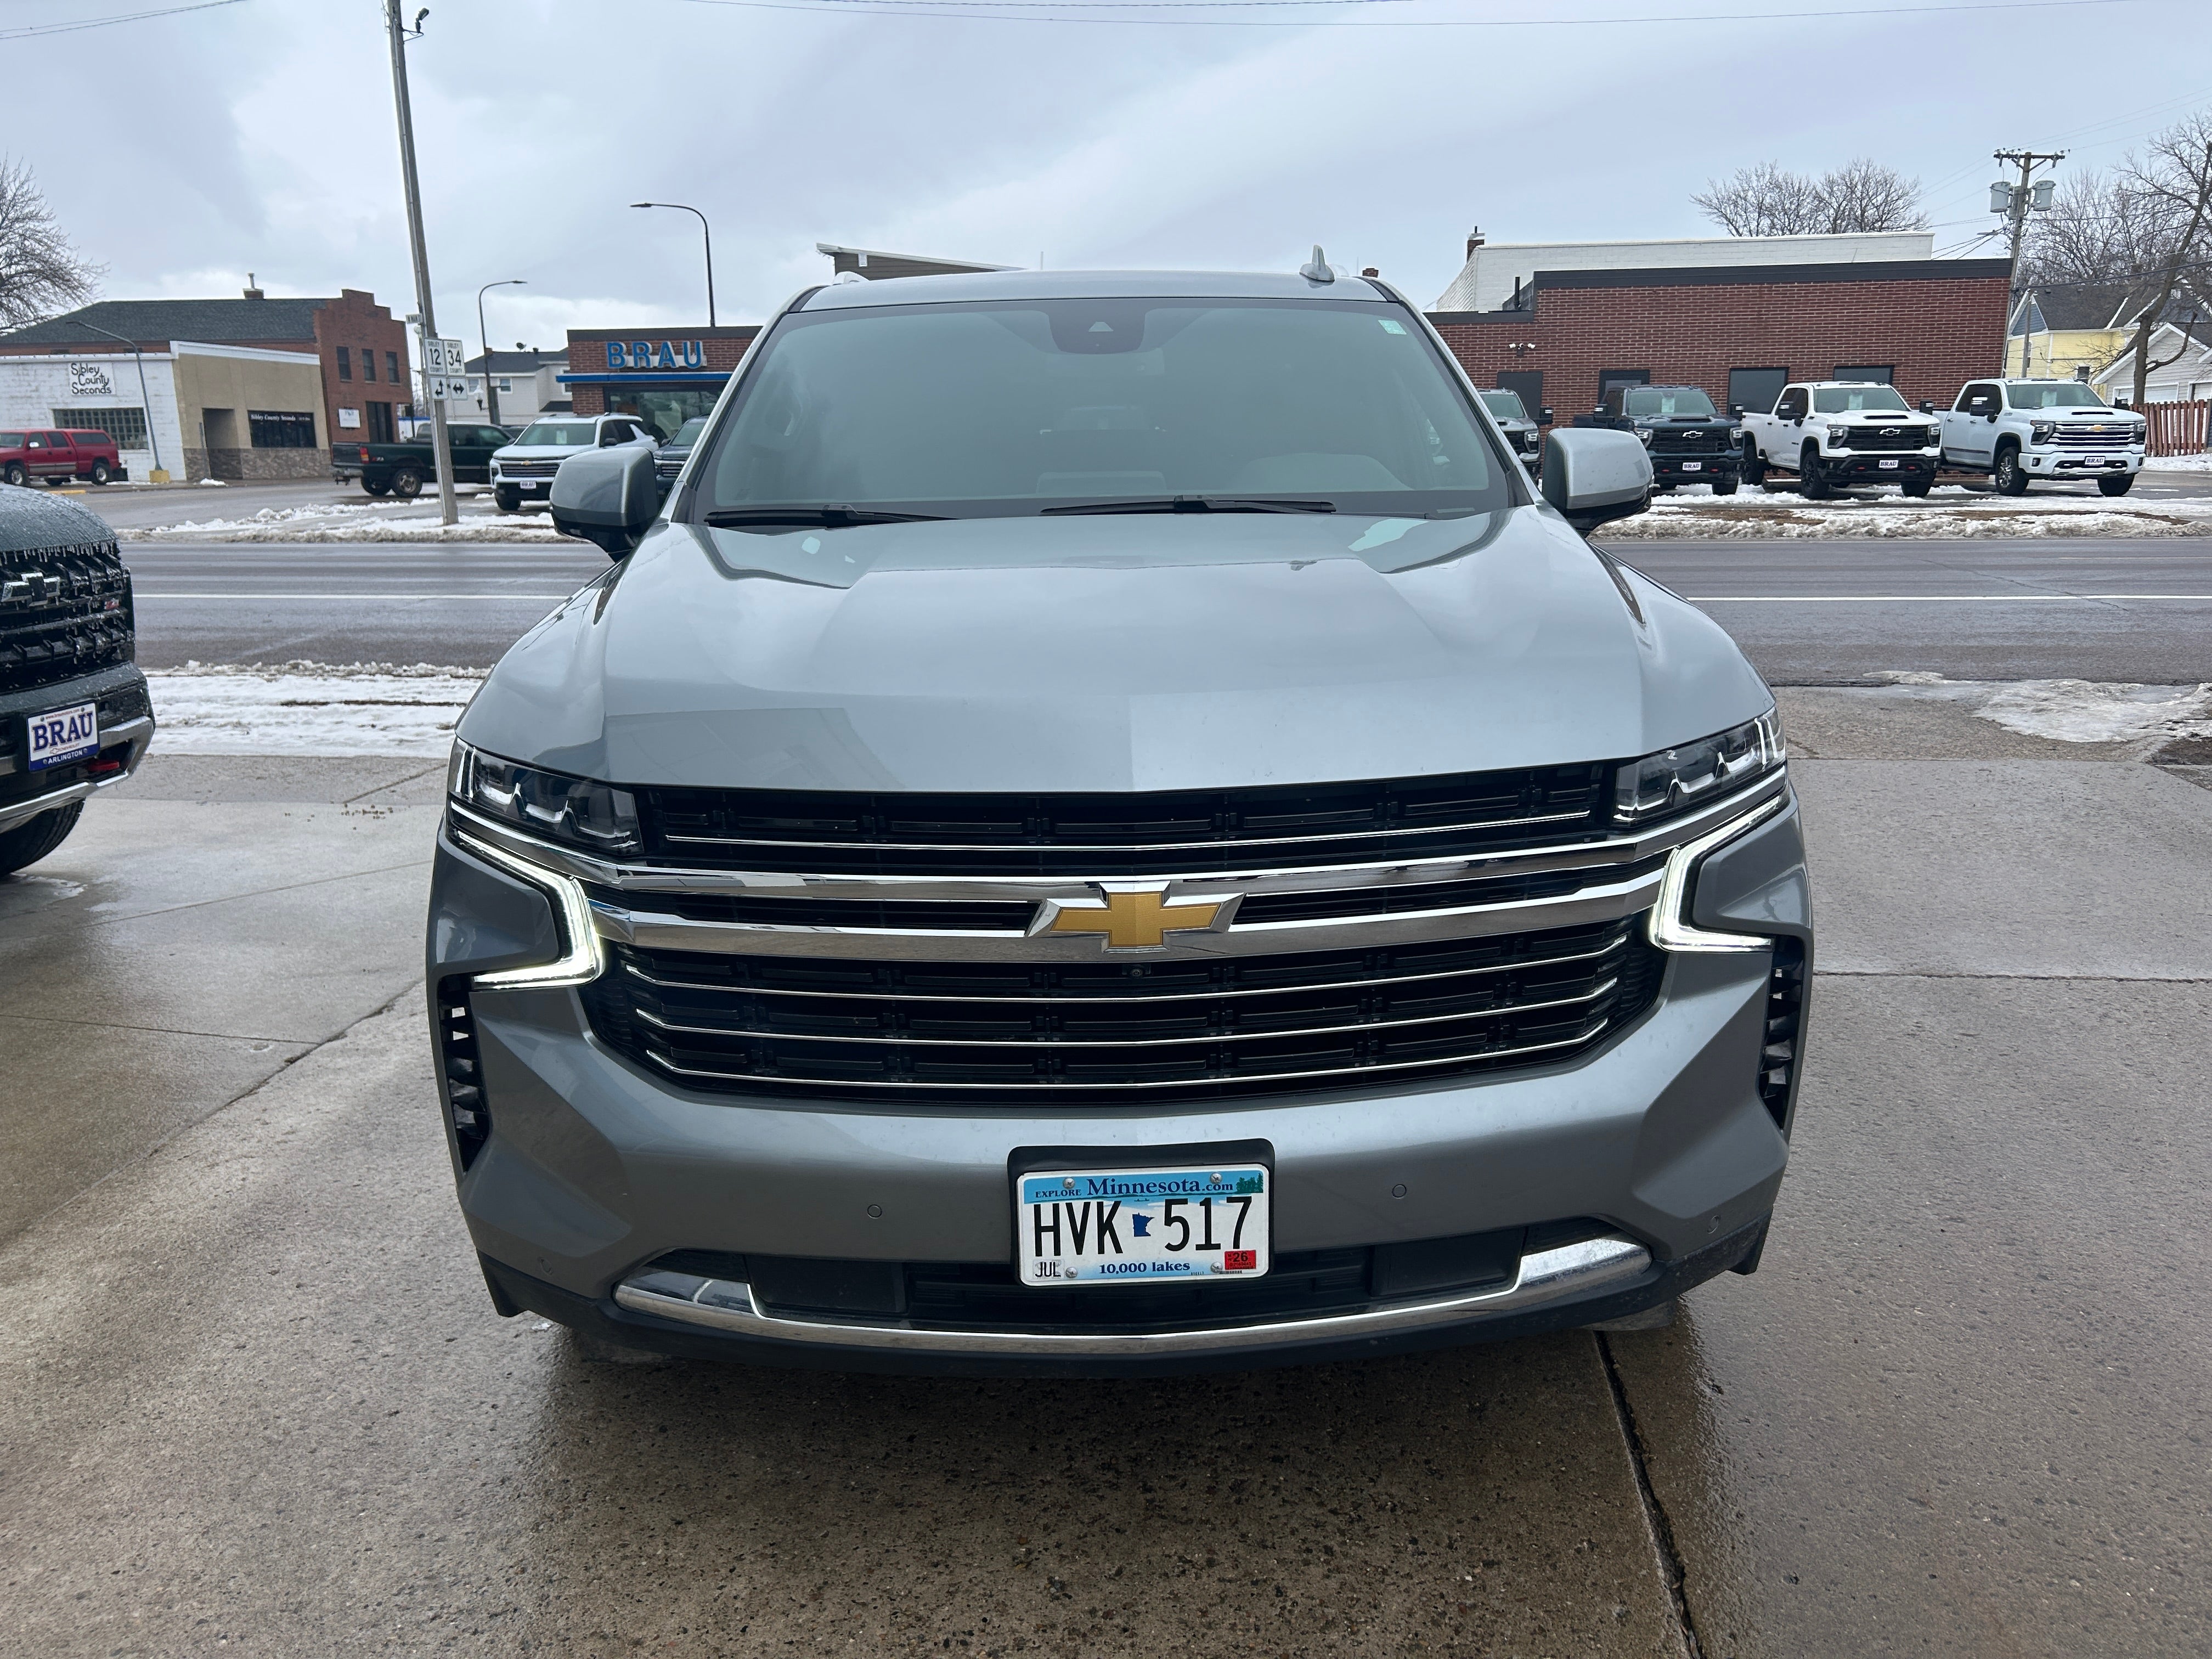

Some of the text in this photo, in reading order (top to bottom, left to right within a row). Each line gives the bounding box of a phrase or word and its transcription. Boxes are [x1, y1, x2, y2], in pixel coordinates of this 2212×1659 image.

[430, 348, 441, 365] 12
[448, 349, 461, 367] 34
[606, 341, 704, 369] BRAU
[71, 362, 100, 377] Sibley
[72, 382, 112, 394] Seconds
[78, 373, 109, 387] County
[31, 710, 93, 753] BRAU
[48, 749, 82, 764] ARLINGTON
[1035, 1178, 1233, 1198] EXPLORE Minnesota.com
[1034, 1196, 1252, 1257] HVK 517
[1233, 1251, 1249, 1262] 26
[1035, 1261, 1062, 1277] JUL
[1099, 1261, 1190, 1275] 10,000 lakes
